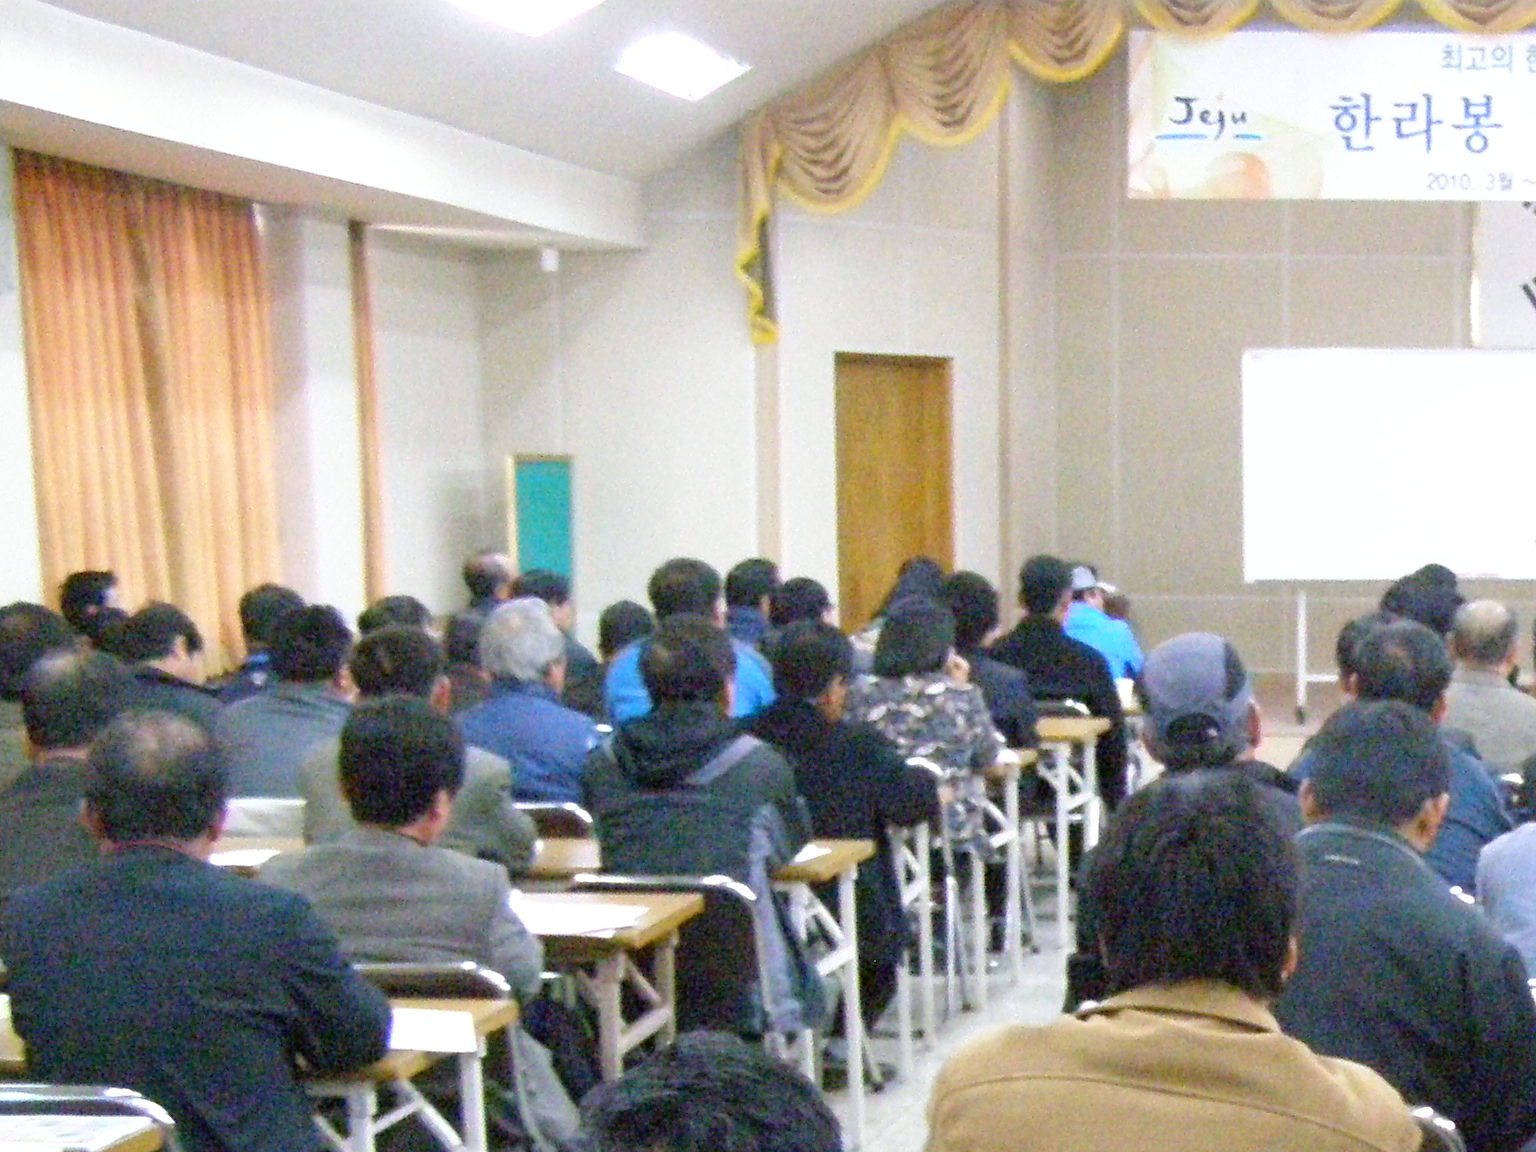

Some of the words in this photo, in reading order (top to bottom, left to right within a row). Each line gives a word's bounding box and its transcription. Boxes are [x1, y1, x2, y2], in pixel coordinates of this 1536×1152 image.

[1441, 44, 1513, 73] 최고의
[1169, 92, 1247, 141] Jeju
[1329, 92, 1503, 154] 한라봉
